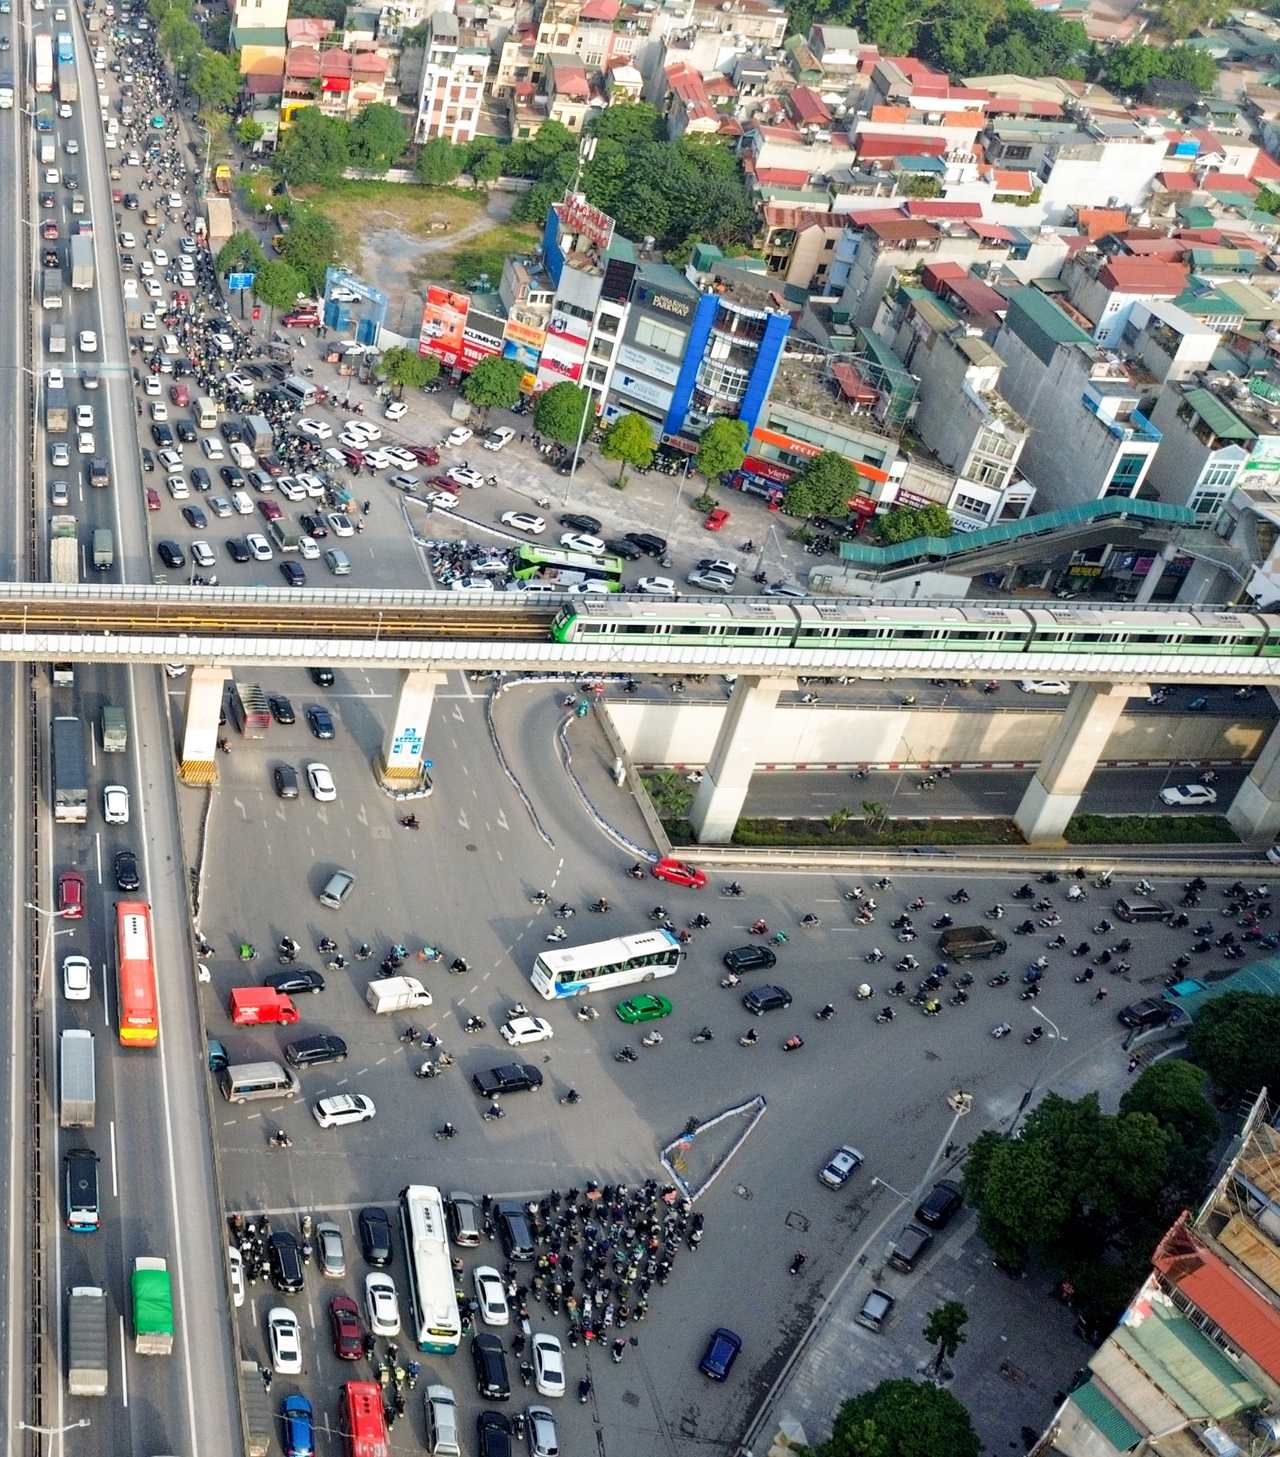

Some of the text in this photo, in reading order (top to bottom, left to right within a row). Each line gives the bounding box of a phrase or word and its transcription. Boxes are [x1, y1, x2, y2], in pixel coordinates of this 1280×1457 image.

[651, 295, 689, 316] PARKWAY
[464, 330, 501, 348] KUMHO
[682, 442, 698, 452] KHOA
